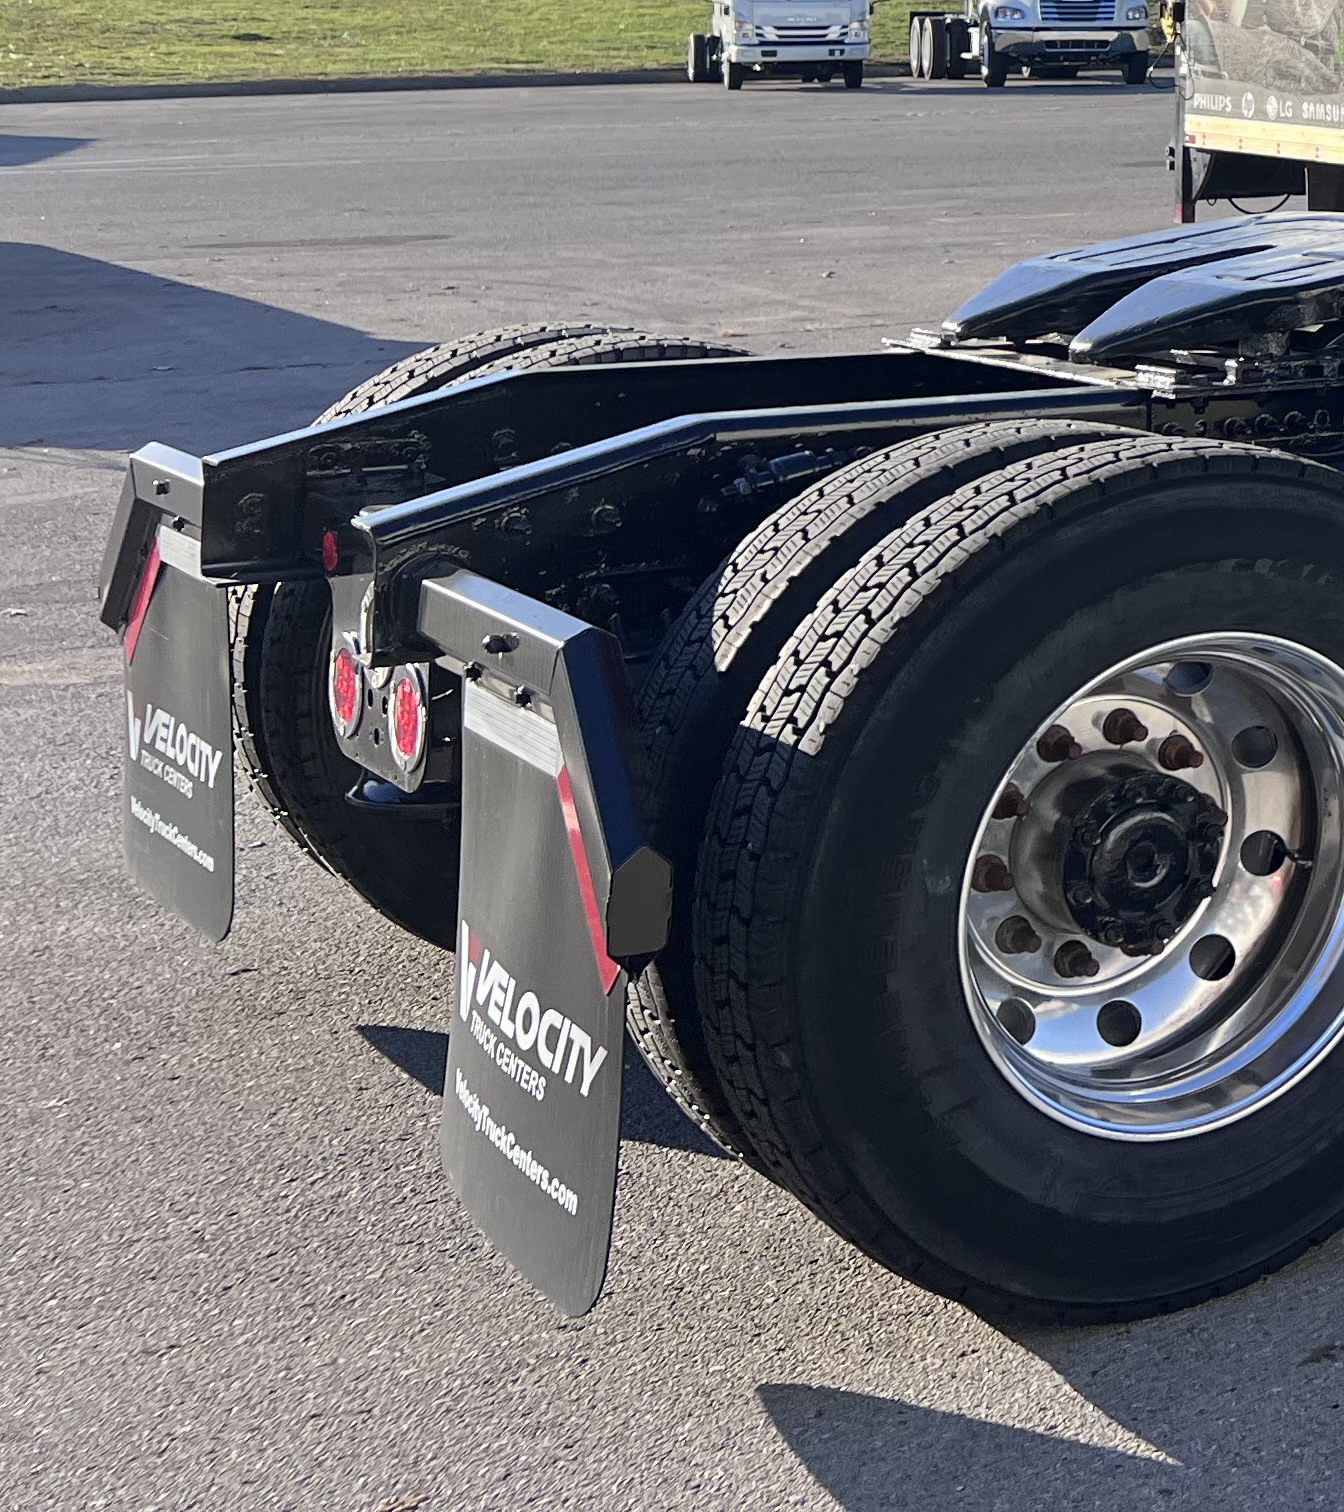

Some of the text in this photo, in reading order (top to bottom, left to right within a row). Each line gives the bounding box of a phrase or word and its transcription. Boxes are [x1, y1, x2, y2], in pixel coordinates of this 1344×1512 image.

[1193, 93, 1232, 113] PHILIPS
[1279, 100, 1293, 118] LG
[140, 749, 164, 779] TRUCK
[143, 703, 223, 789] VELOCITY
[469, 1009, 547, 1101] TRUCK CENTERS
[475, 948, 608, 1097] VELOCITY
[455, 1067, 579, 1216] VelocityTruckCenters.com
